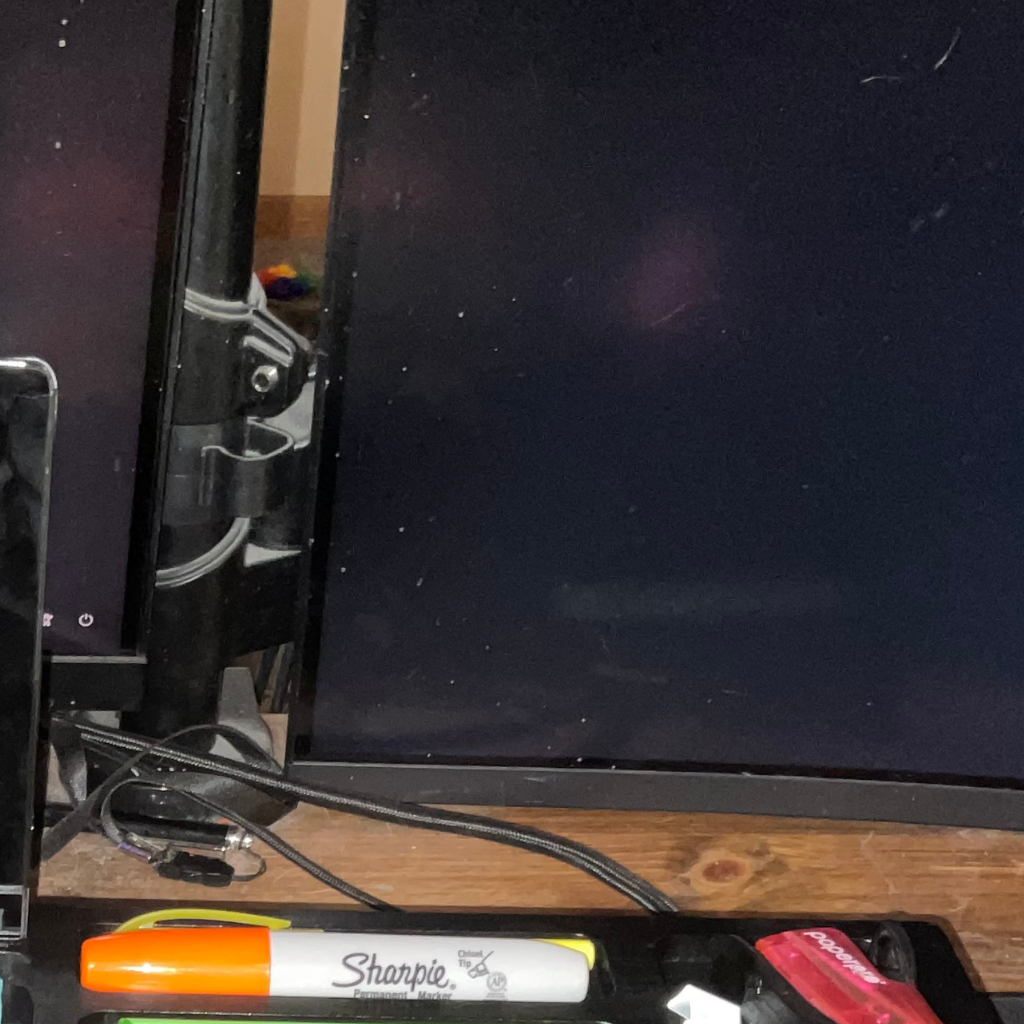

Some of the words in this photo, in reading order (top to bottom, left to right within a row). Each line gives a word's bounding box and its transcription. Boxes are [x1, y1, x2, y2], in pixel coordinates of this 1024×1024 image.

[459, 959, 472, 968] Tip
[331, 953, 450, 992] Sharpie
[353, 989, 408, 1000] Permanent
[418, 991, 453, 1000] Marker
